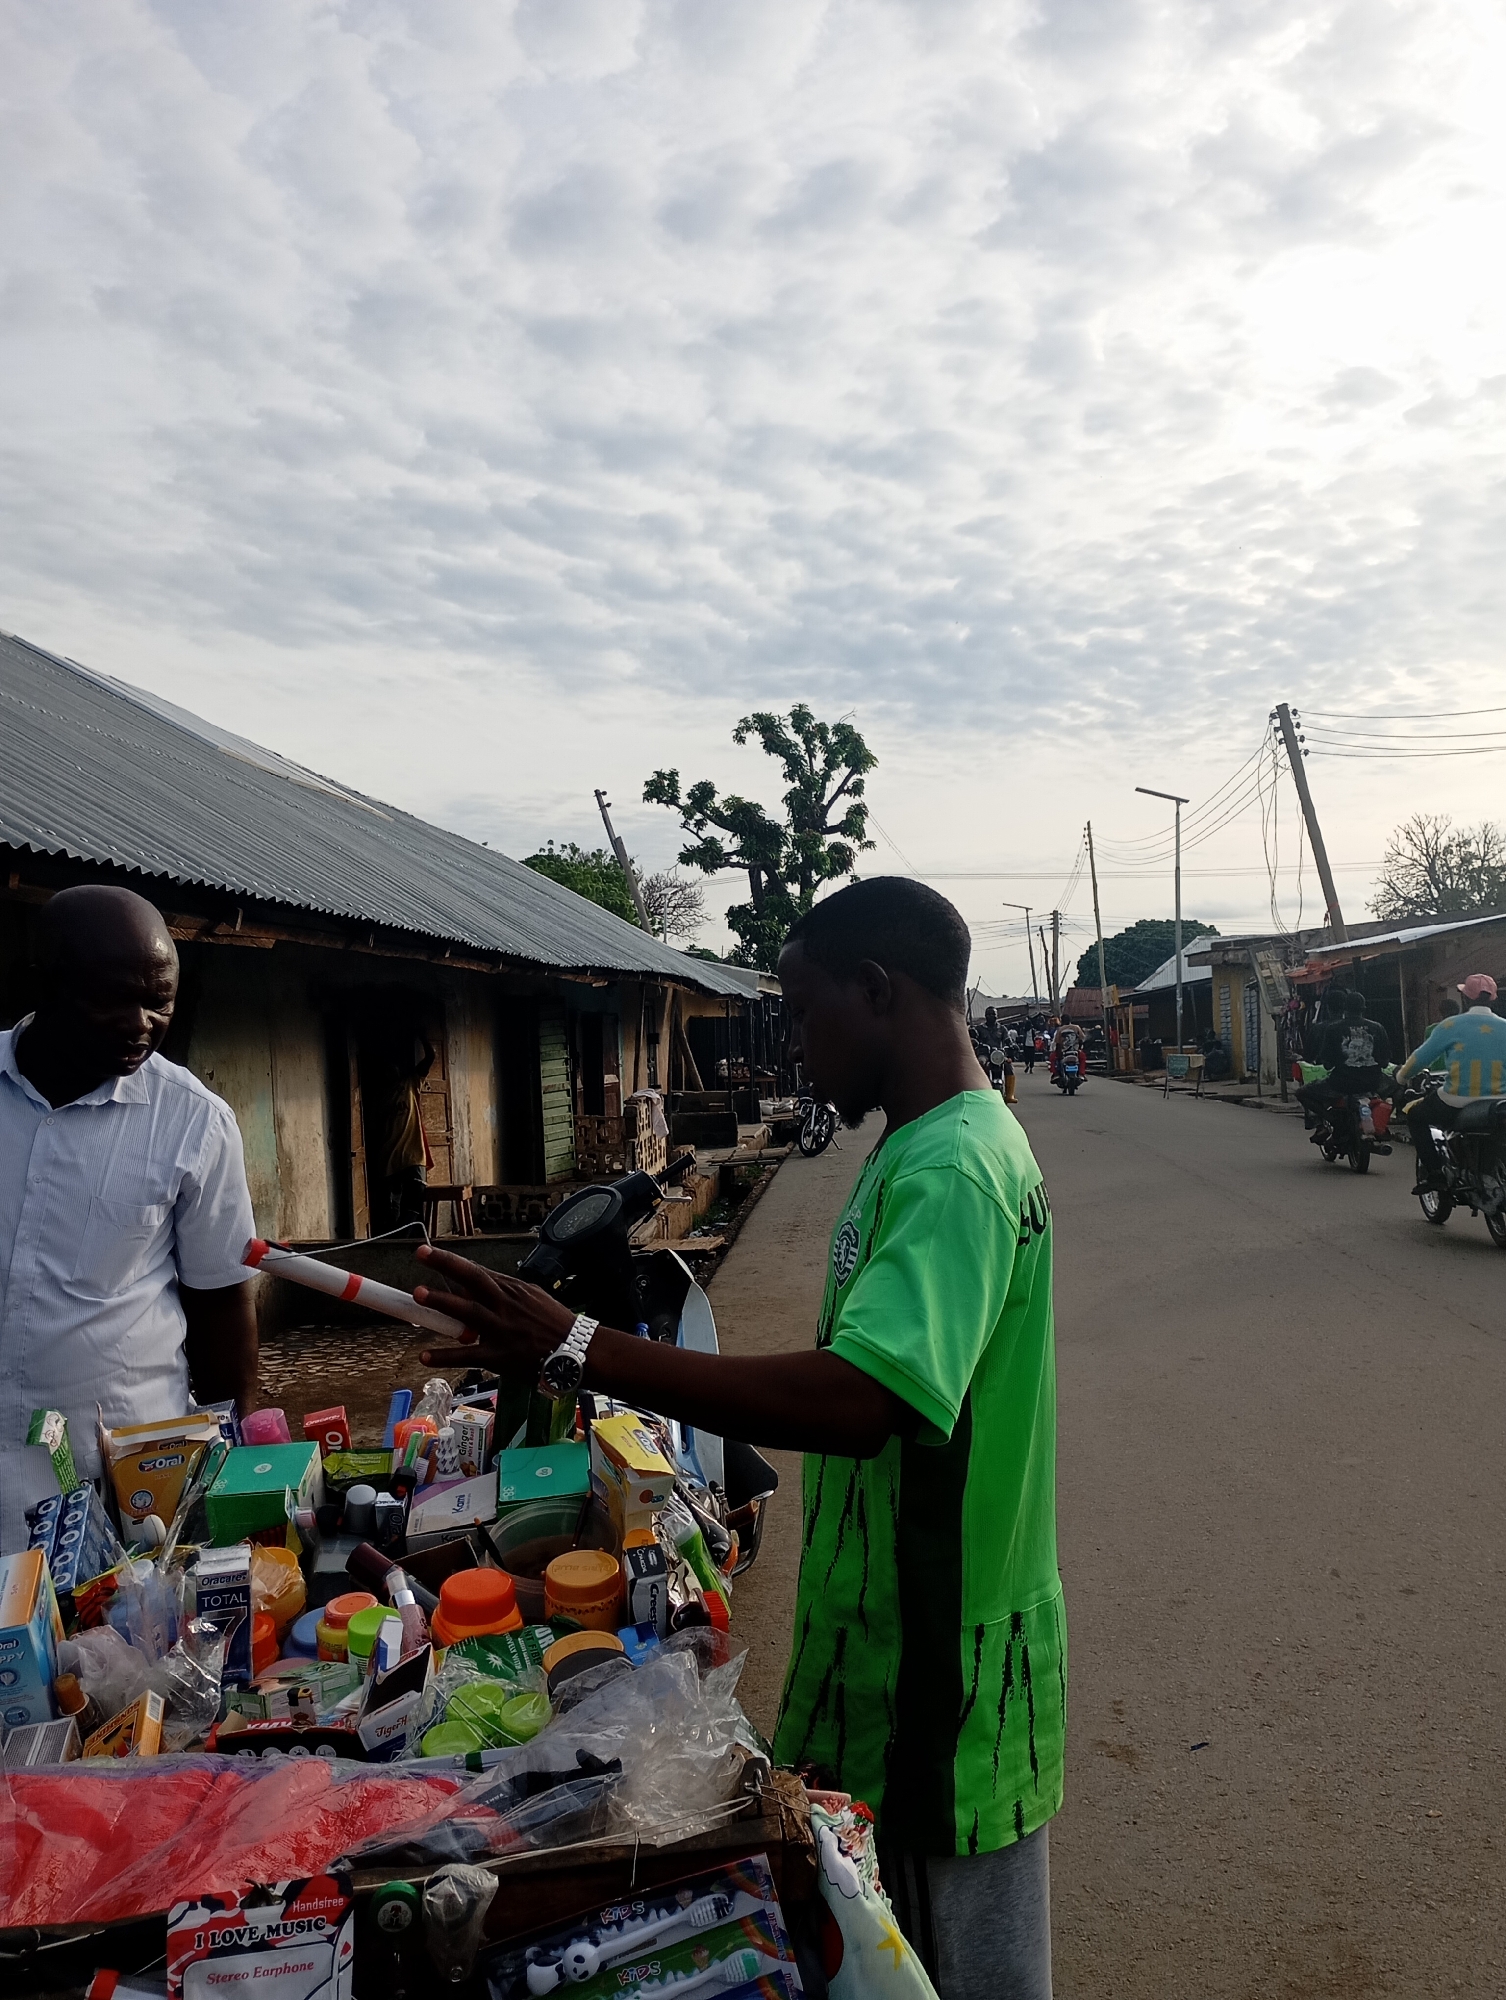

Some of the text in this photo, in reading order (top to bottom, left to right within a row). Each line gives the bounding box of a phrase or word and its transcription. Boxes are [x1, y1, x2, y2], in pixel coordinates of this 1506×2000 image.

[457, 1425, 470, 1456] Ginger
[156, 1455, 183, 1468] Oral
[452, 1493, 466, 1515] Kami
[201, 1592, 248, 1608] TOTAL
[292, 1895, 345, 1913] Handsfree
[194, 1916, 327, 1950] I LOVE MUSIC
[206, 1959, 315, 1986] Stereo Earphone
